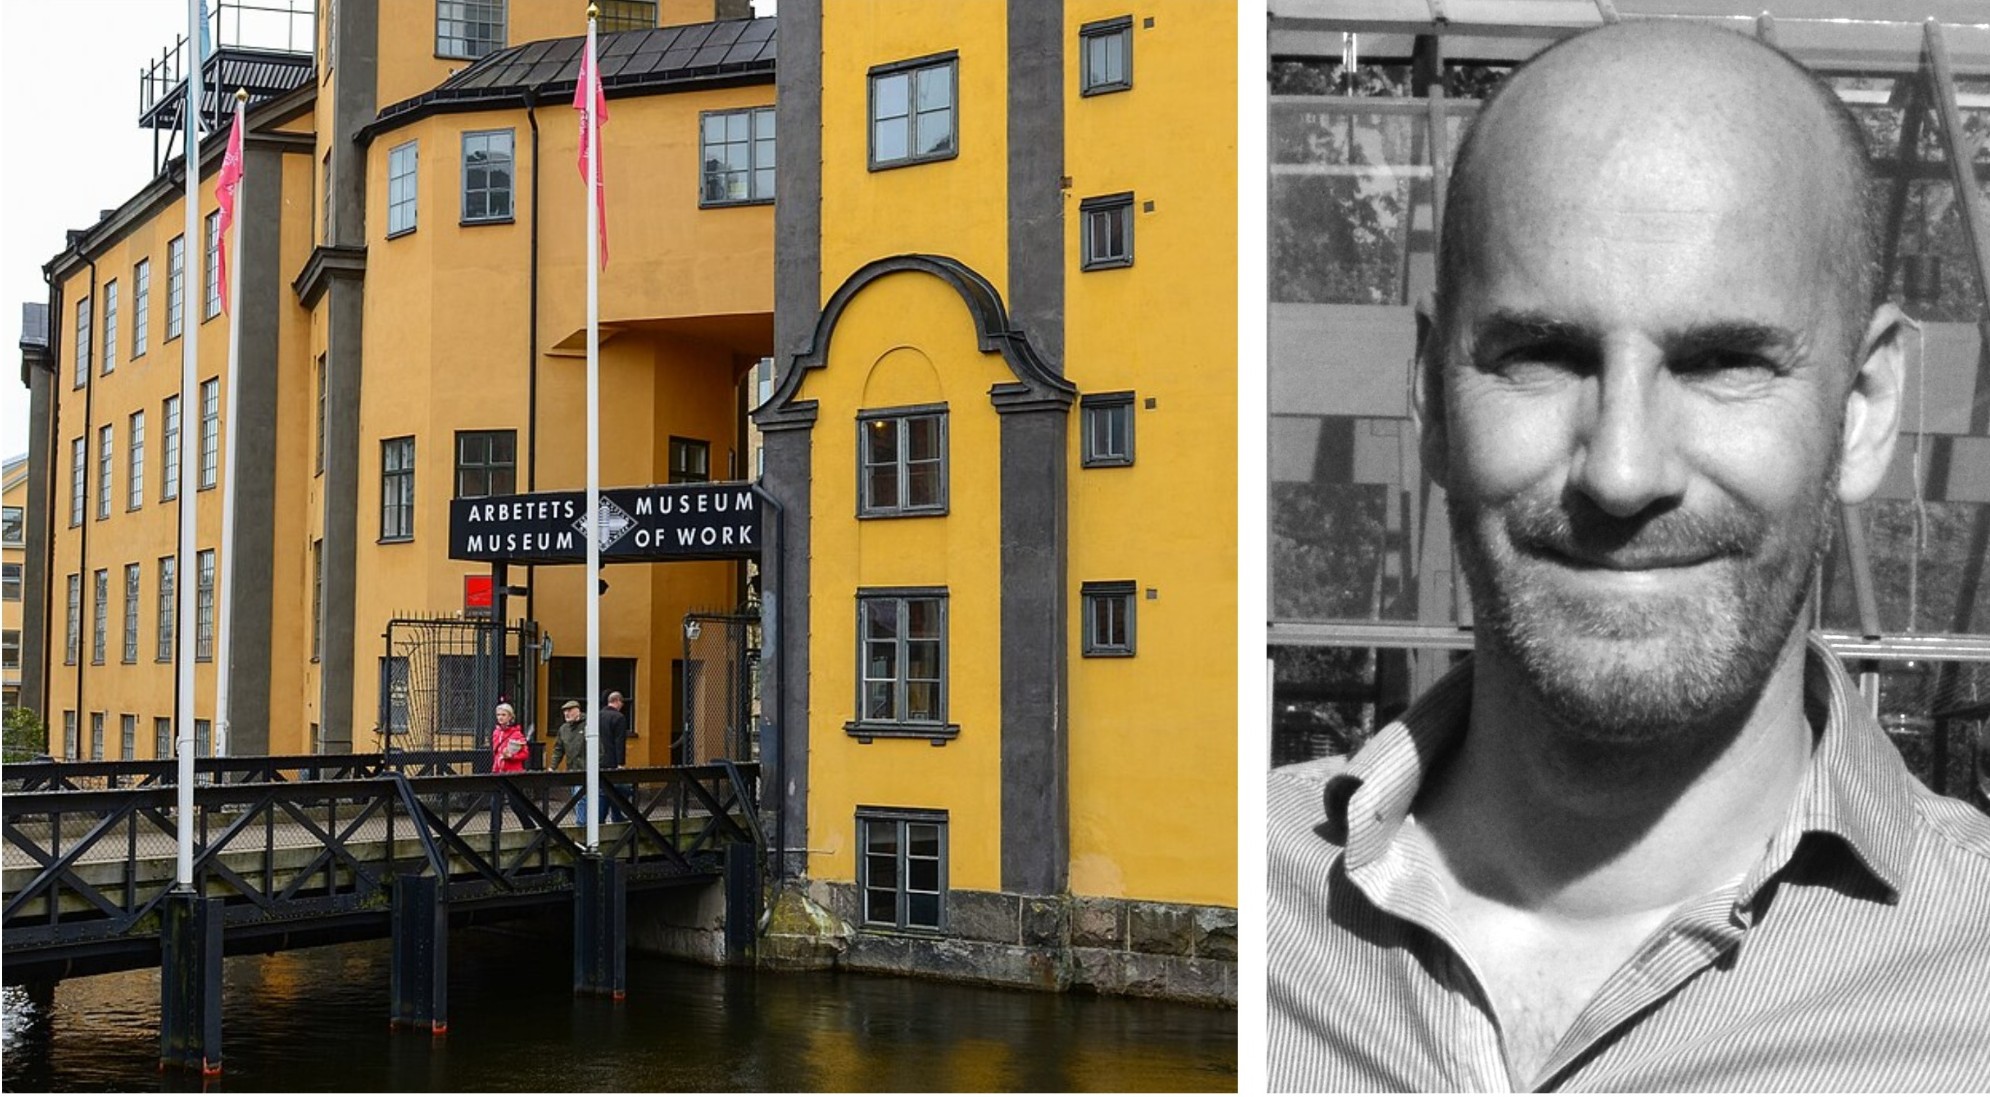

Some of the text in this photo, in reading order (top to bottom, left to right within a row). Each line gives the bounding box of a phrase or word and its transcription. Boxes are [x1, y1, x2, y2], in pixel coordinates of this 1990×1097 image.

[468, 500, 574, 522] ARBETETS
[635, 491, 753, 516] MUSEUM
[467, 531, 573, 553] MUSEUM
[634, 528, 665, 548] OF
[676, 525, 752, 546] WORK
